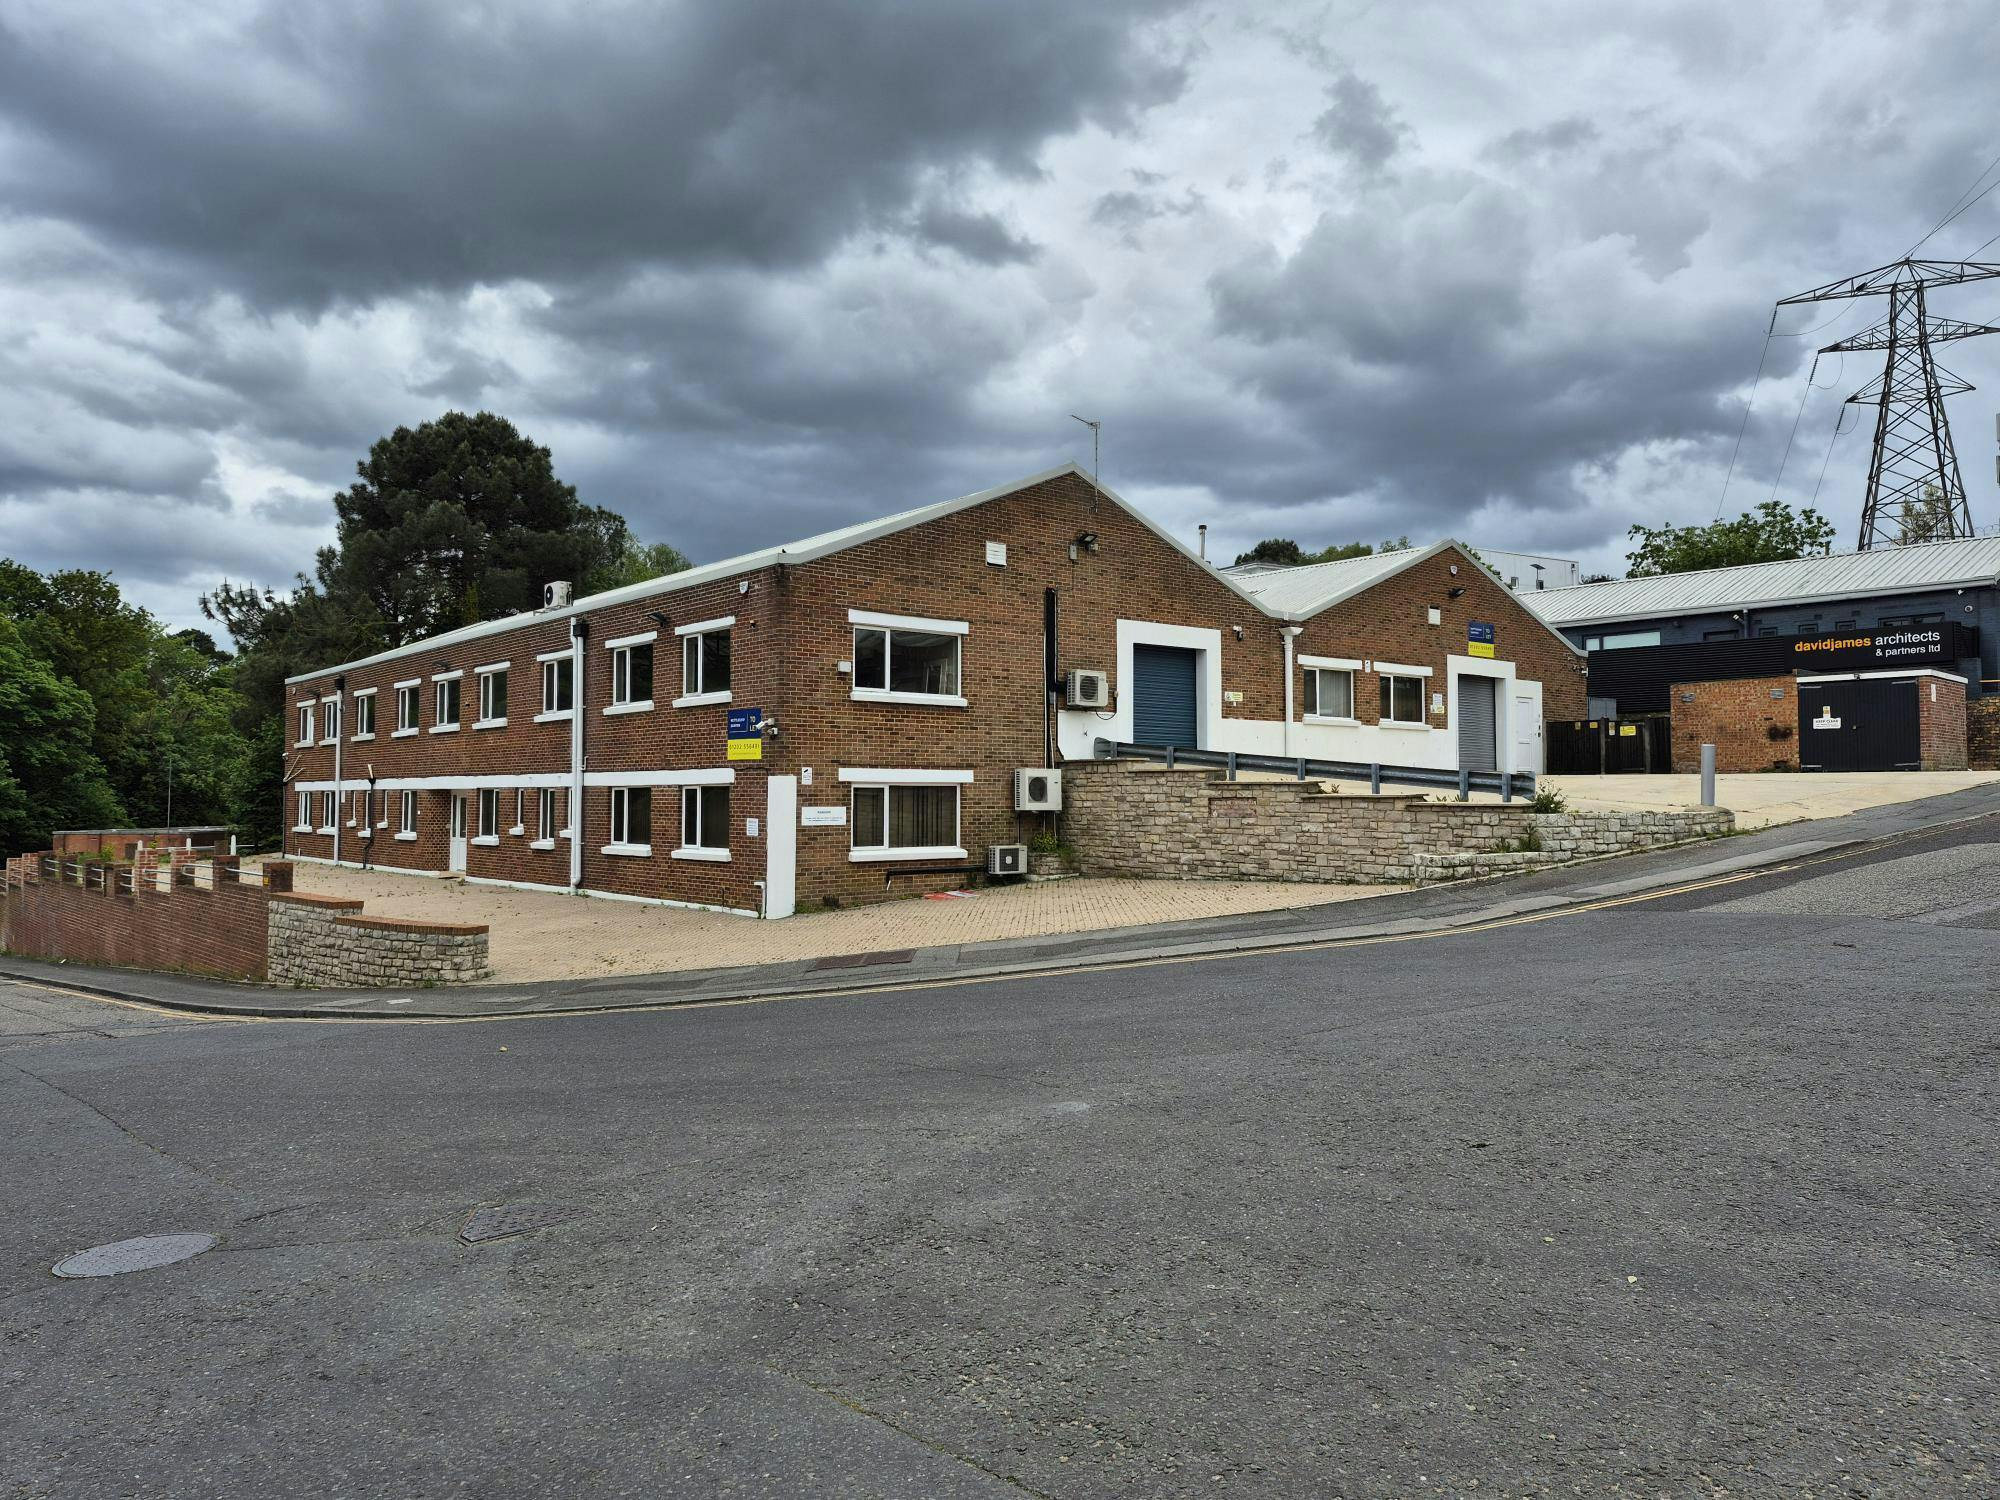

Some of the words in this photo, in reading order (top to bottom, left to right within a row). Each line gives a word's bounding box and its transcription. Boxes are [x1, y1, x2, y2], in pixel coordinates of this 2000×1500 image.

[1795, 637, 1872, 652] davidjames
[1875, 631, 1941, 646] architects
[1875, 648, 1883, 657] &
[1885, 645, 1926, 658] partners
[1928, 643, 1941, 653] ltd
